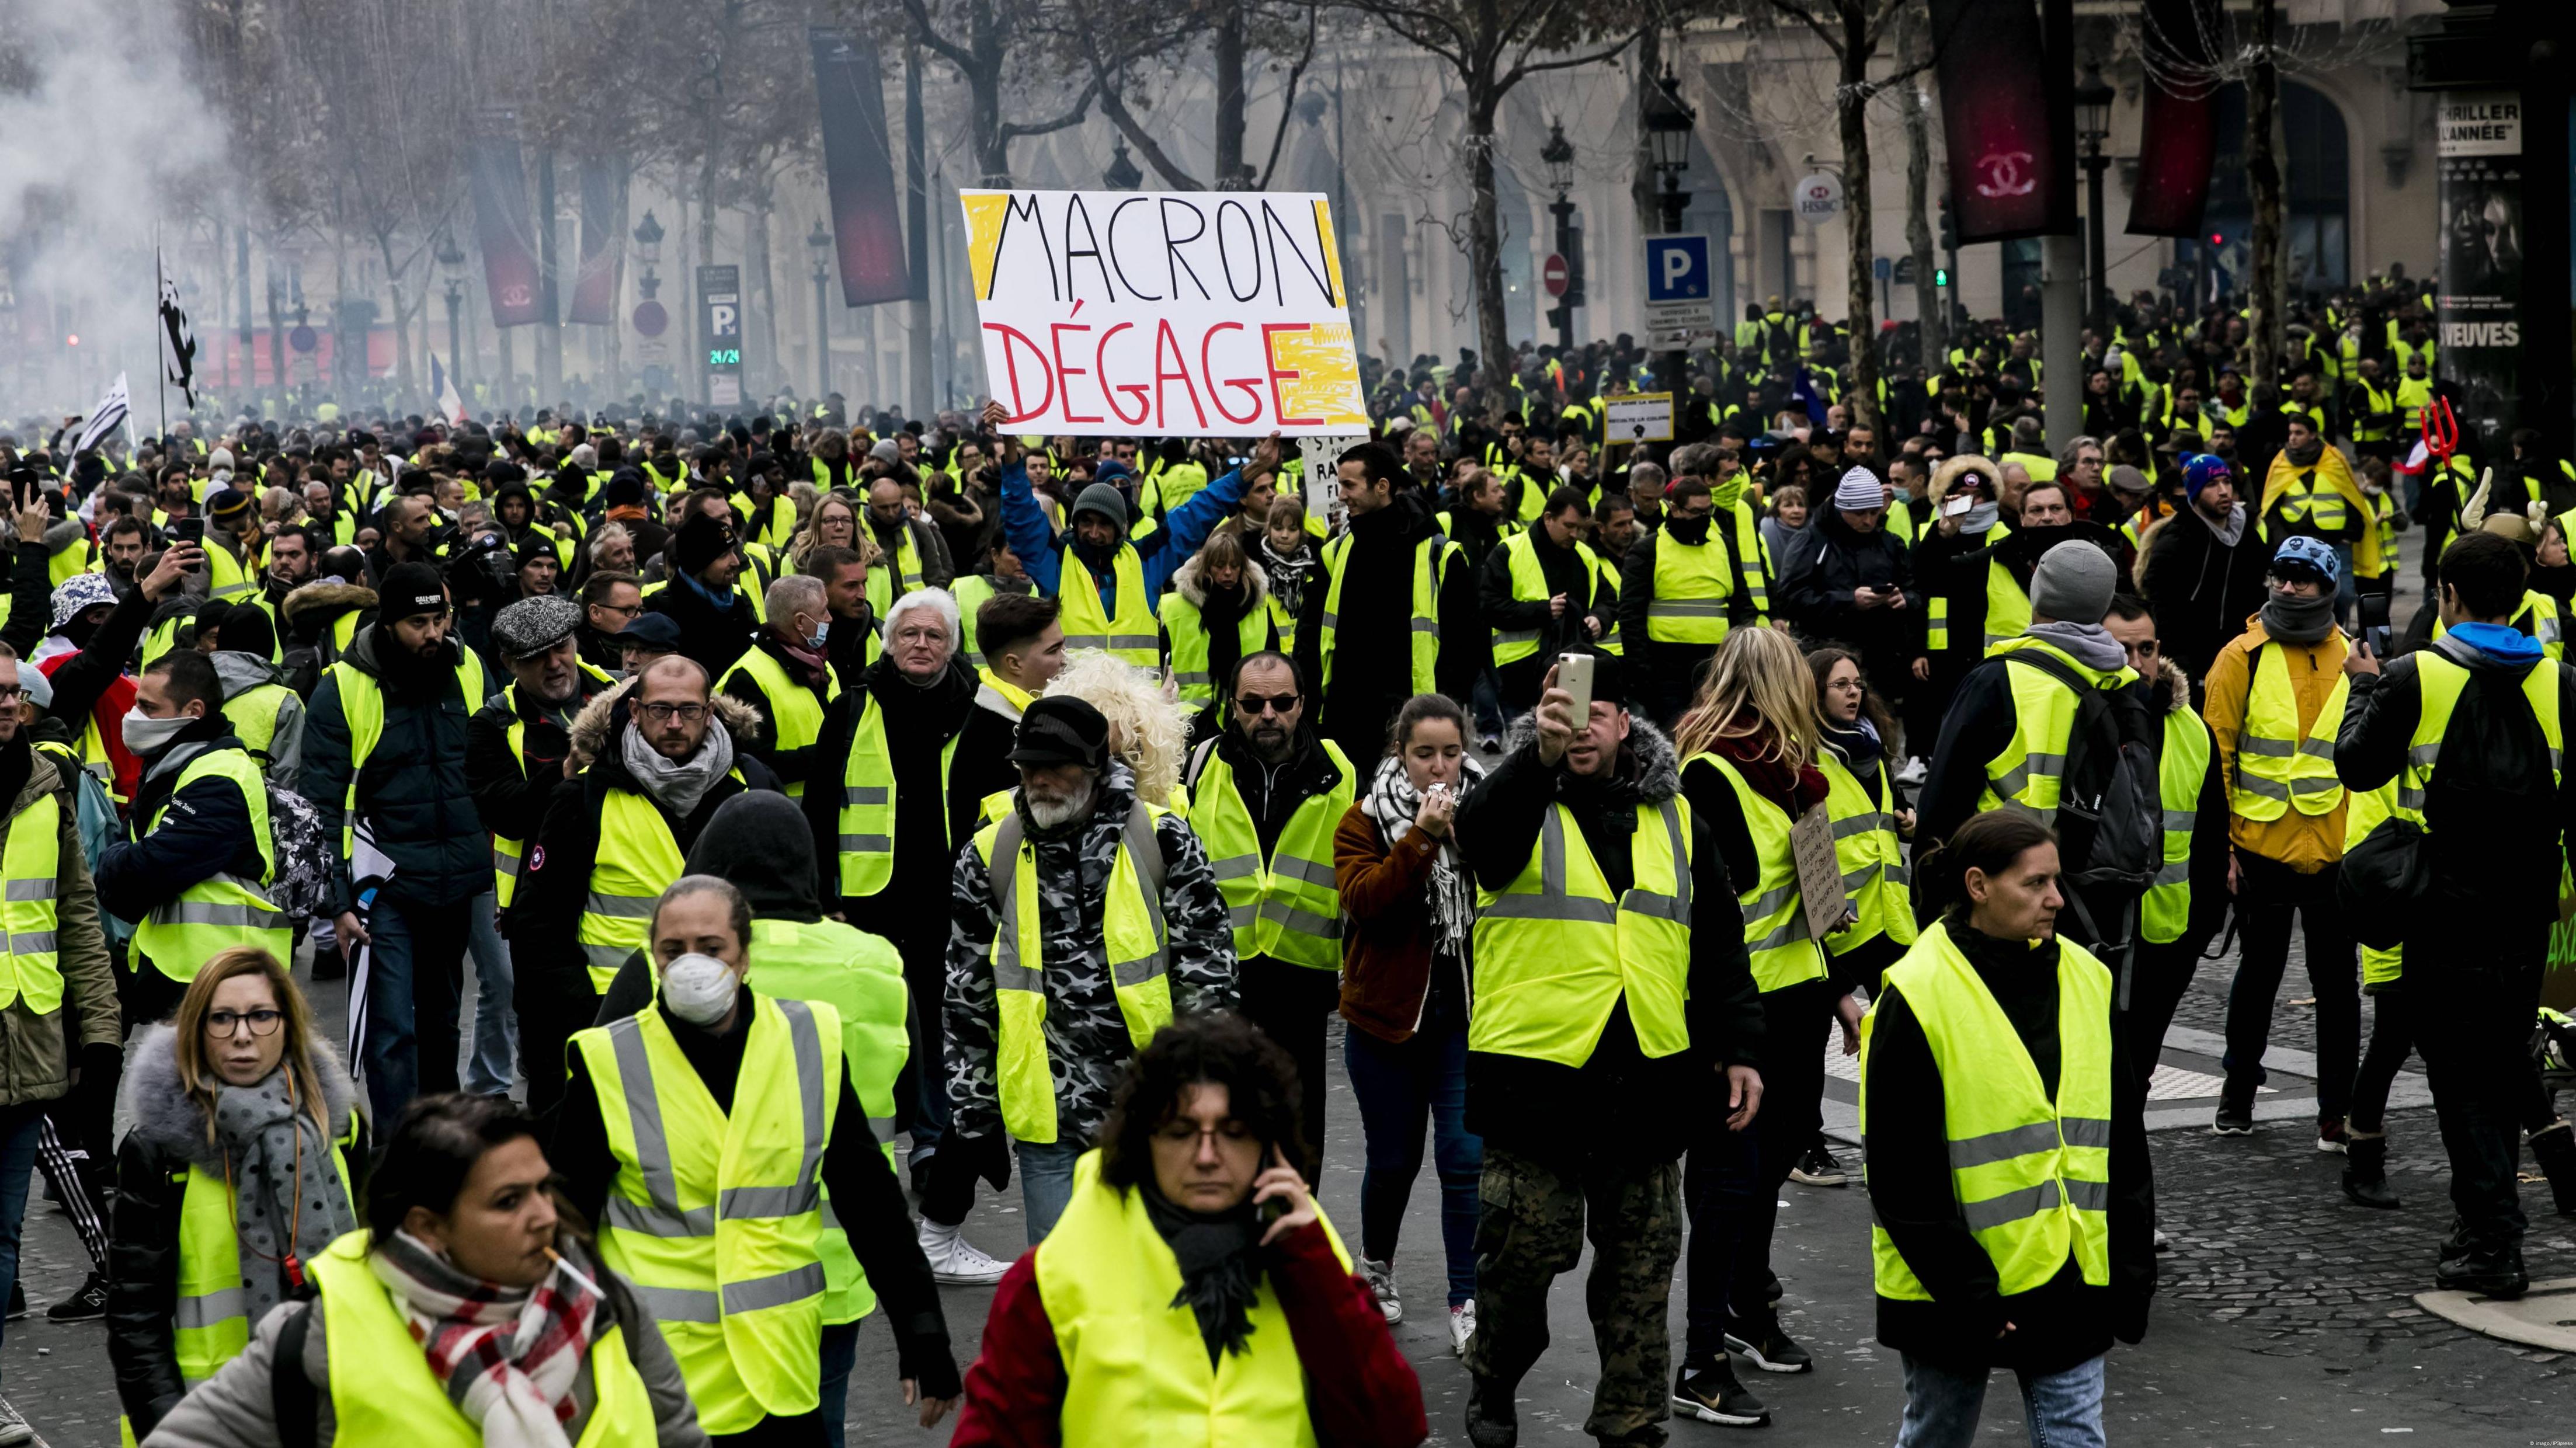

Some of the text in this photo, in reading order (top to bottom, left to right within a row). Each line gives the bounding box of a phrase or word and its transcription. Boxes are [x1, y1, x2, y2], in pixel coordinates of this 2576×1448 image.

[1803, 200, 1838, 213] HSBC
[988, 193, 1337, 308] MACRON
[1663, 249, 1692, 290] P
[711, 305, 736, 336] P
[2445, 322, 2520, 347] VEUVES
[710, 349, 740, 364] 24/24
[983, 298, 1325, 429] DÉGAGE
[1331, 447, 1343, 457] AU
[182, 803, 196, 814] 2000
